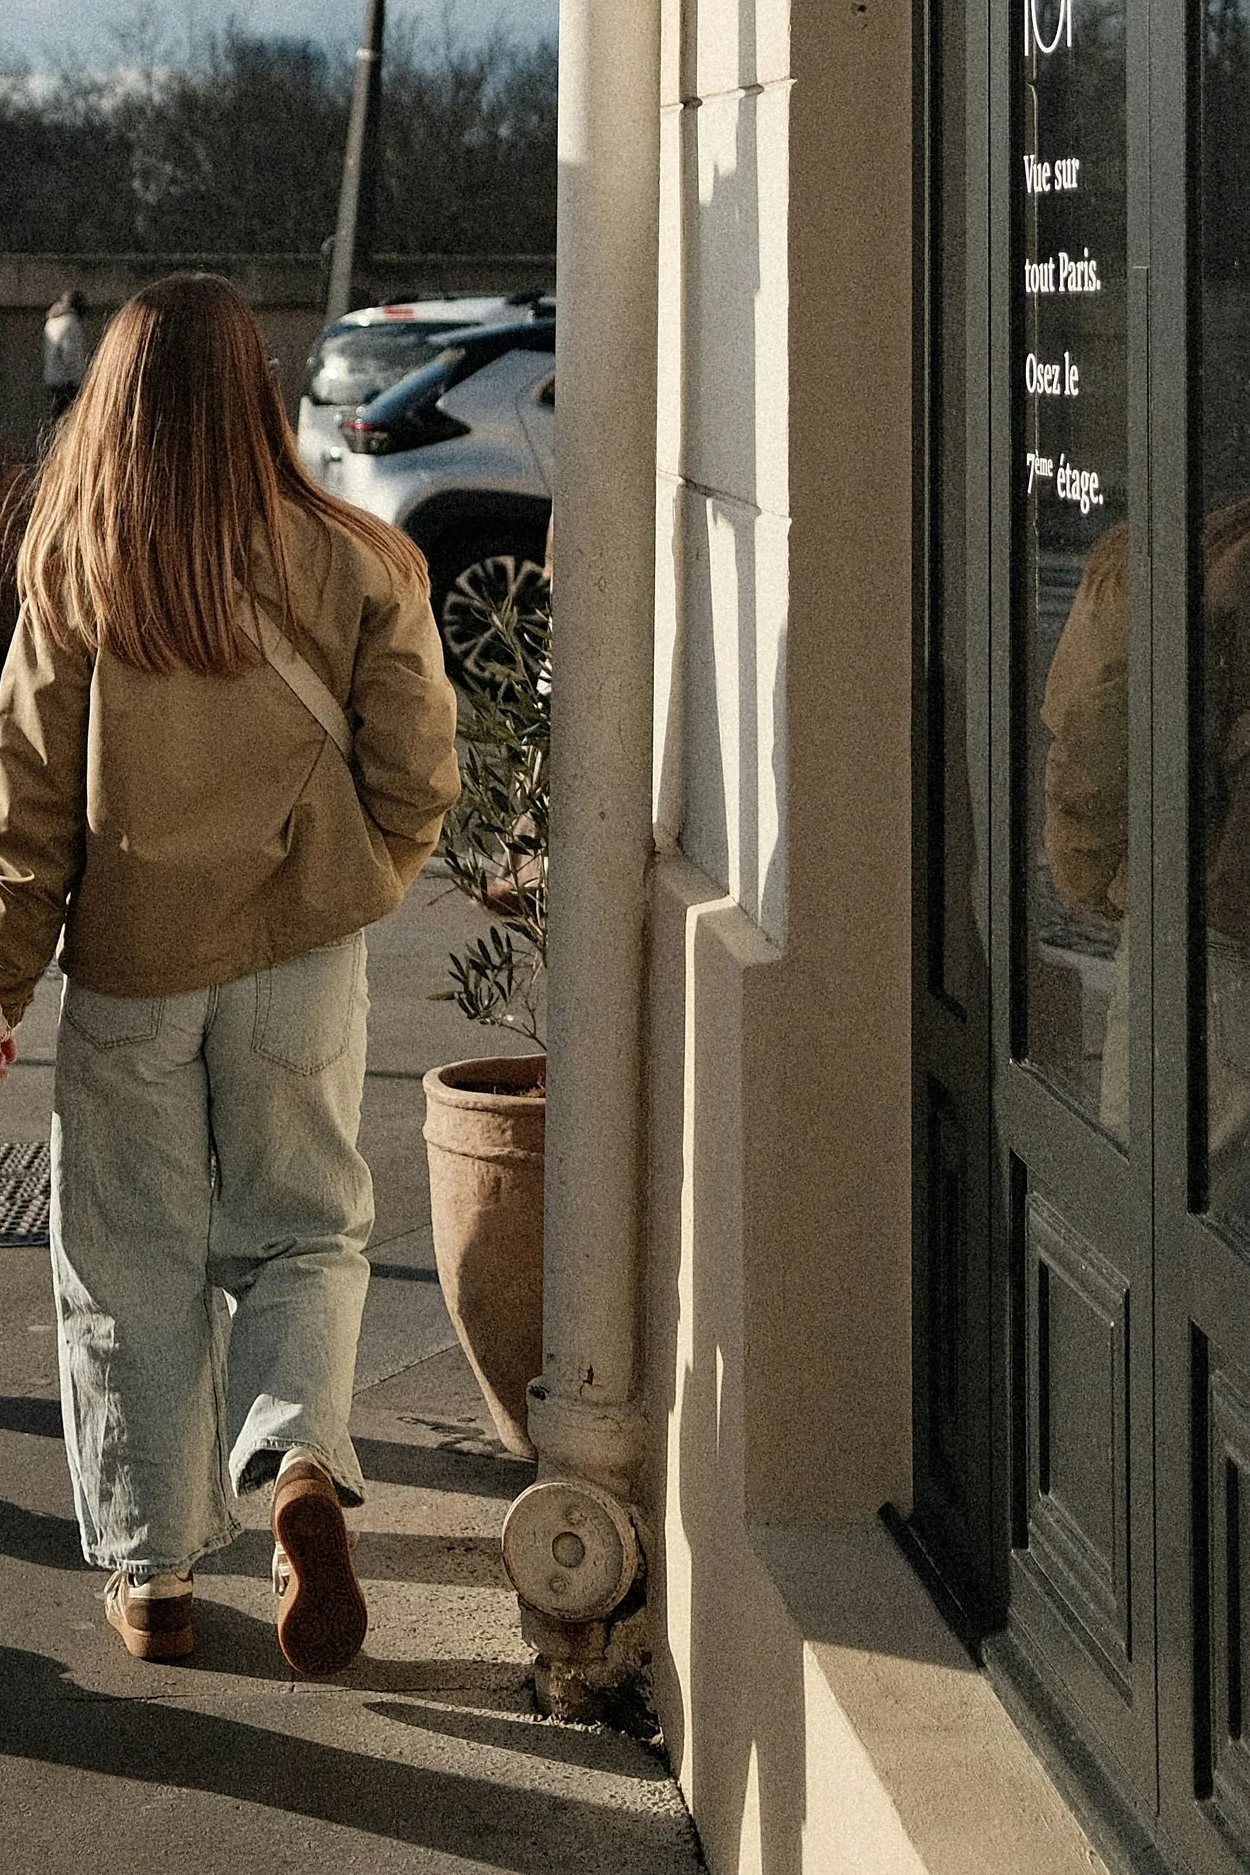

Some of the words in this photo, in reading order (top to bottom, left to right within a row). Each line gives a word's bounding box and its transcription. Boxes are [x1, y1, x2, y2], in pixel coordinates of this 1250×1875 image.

[1023, 154, 1050, 193] Vue
[1054, 158, 1080, 191] sur
[1024, 257, 1055, 292] tout
[1058, 247, 1101, 292] Paris.
[1025, 352, 1061, 394] Osez
[1064, 350, 1079, 396] le
[1026, 449, 1053, 494] 7ème
[1057, 453, 1104, 514] étage.
